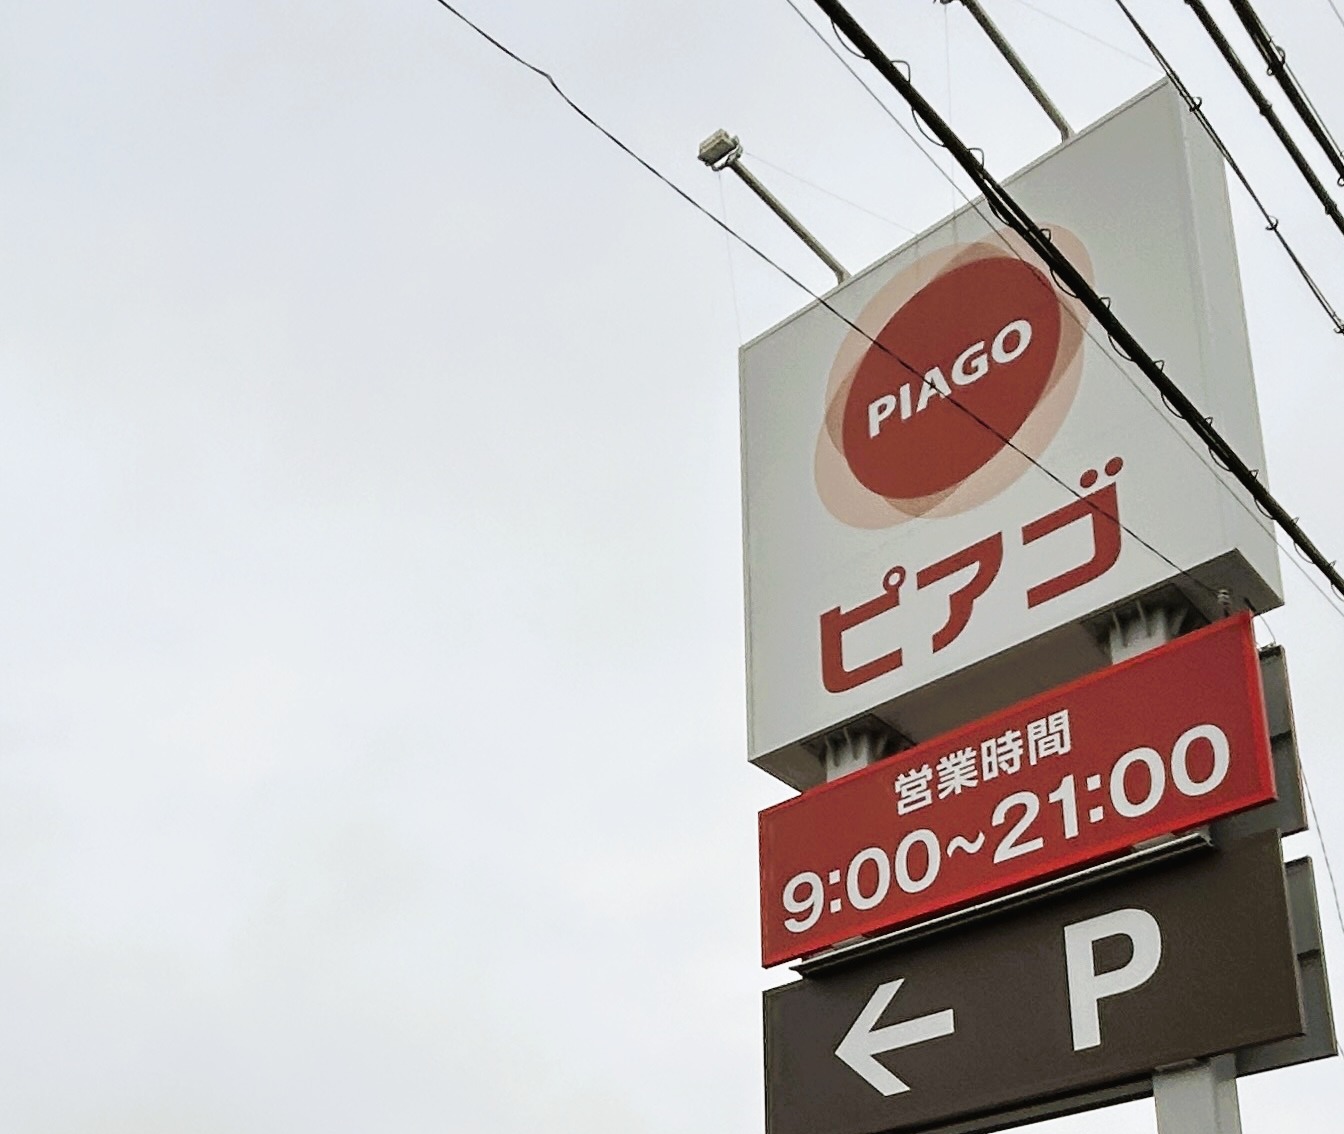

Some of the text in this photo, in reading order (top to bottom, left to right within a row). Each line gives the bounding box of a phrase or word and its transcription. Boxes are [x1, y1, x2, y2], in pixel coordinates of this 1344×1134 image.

[866, 319, 1033, 439] PIAGO
[818, 455, 1125, 694] ピアゴ
[893, 709, 1073, 816] 営業時間
[1063, 908, 1163, 1052] P
